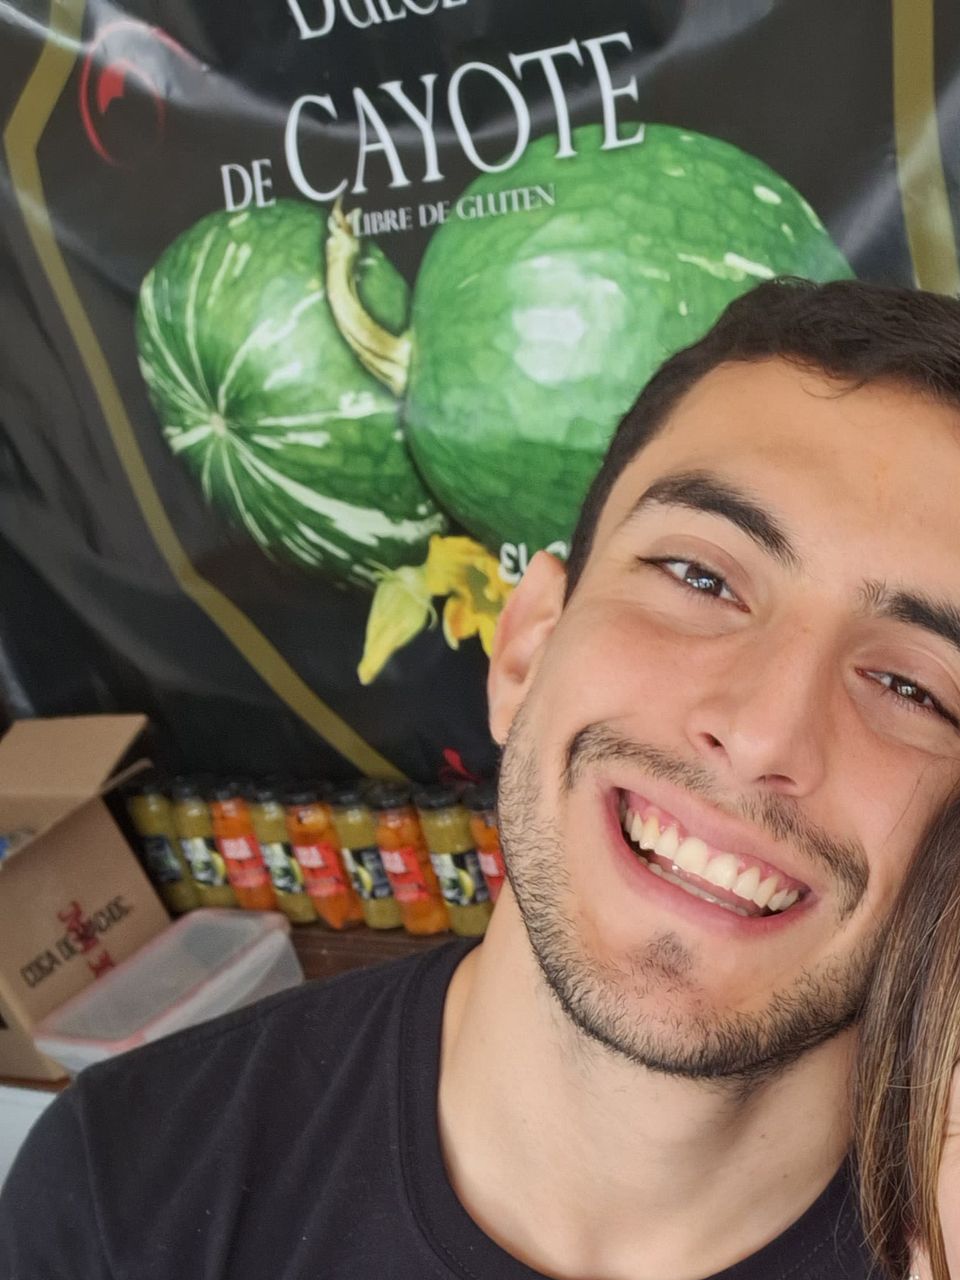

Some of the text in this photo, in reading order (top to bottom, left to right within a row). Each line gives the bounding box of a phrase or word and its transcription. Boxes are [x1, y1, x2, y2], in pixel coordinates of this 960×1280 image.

[219, 31, 646, 213] DE CAYOTE
[351, 183, 556, 237] LIBRE DE GLUTEN
